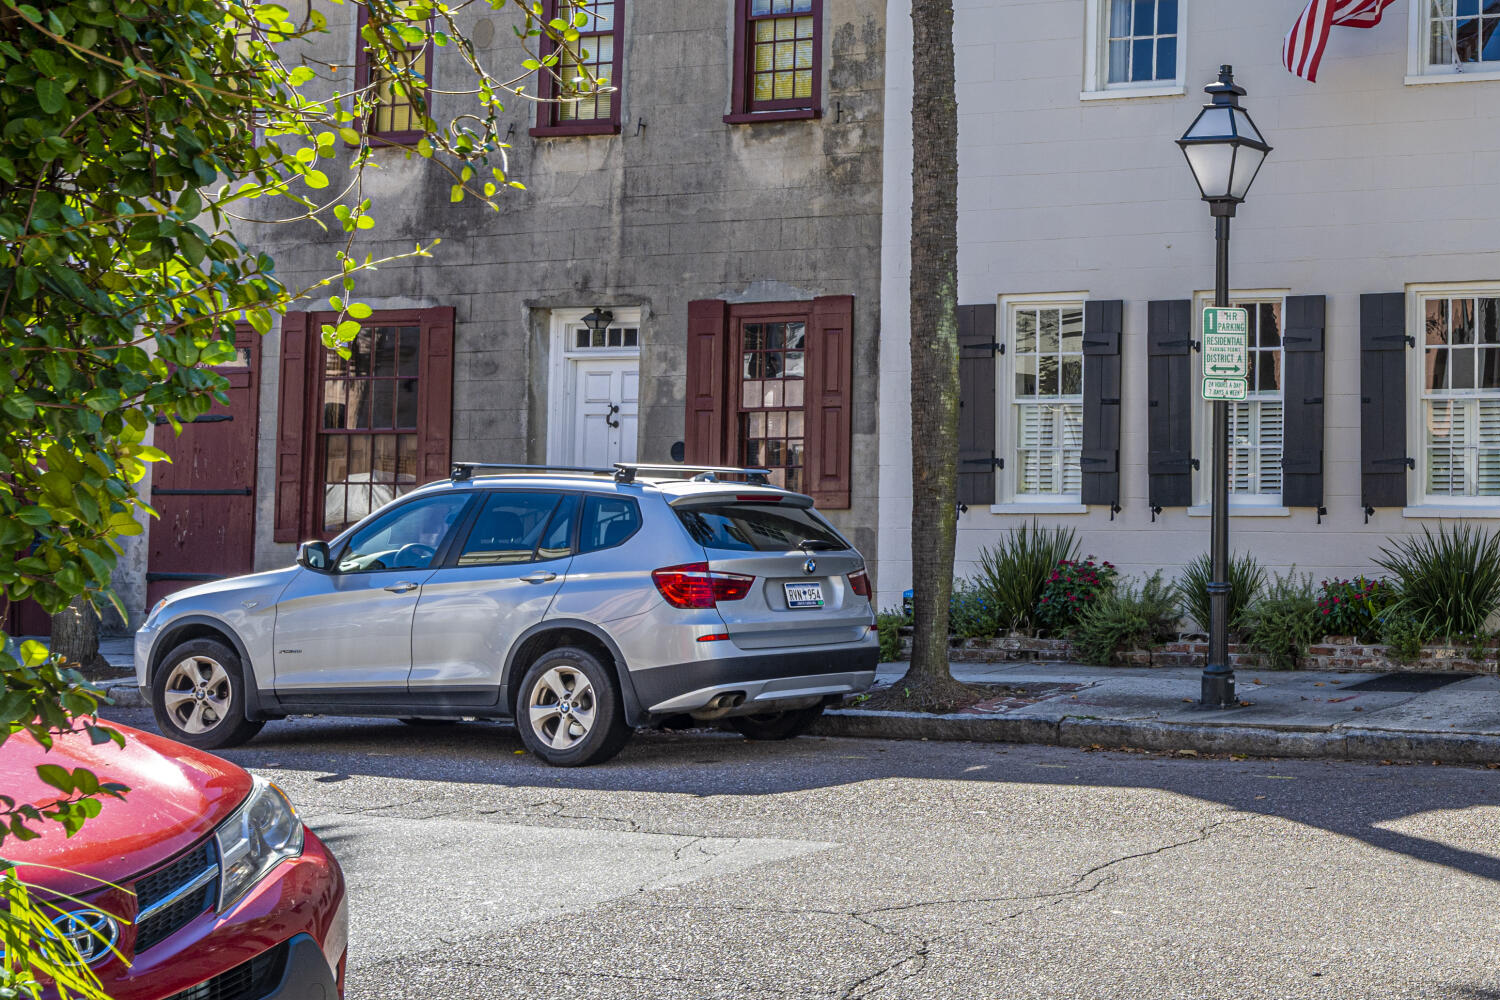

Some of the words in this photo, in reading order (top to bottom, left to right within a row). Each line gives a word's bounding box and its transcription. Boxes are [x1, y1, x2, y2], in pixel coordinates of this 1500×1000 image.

[1208, 312, 1213, 330] 1
[1226, 312, 1238, 320] HR
[1217, 323, 1245, 331] PARKING
[1207, 337, 1243, 345] RESIDENTIAL
[1207, 354, 1234, 363] DISTRICT
[1237, 354, 1242, 363] A
[788, 589, 803, 600] RVN
